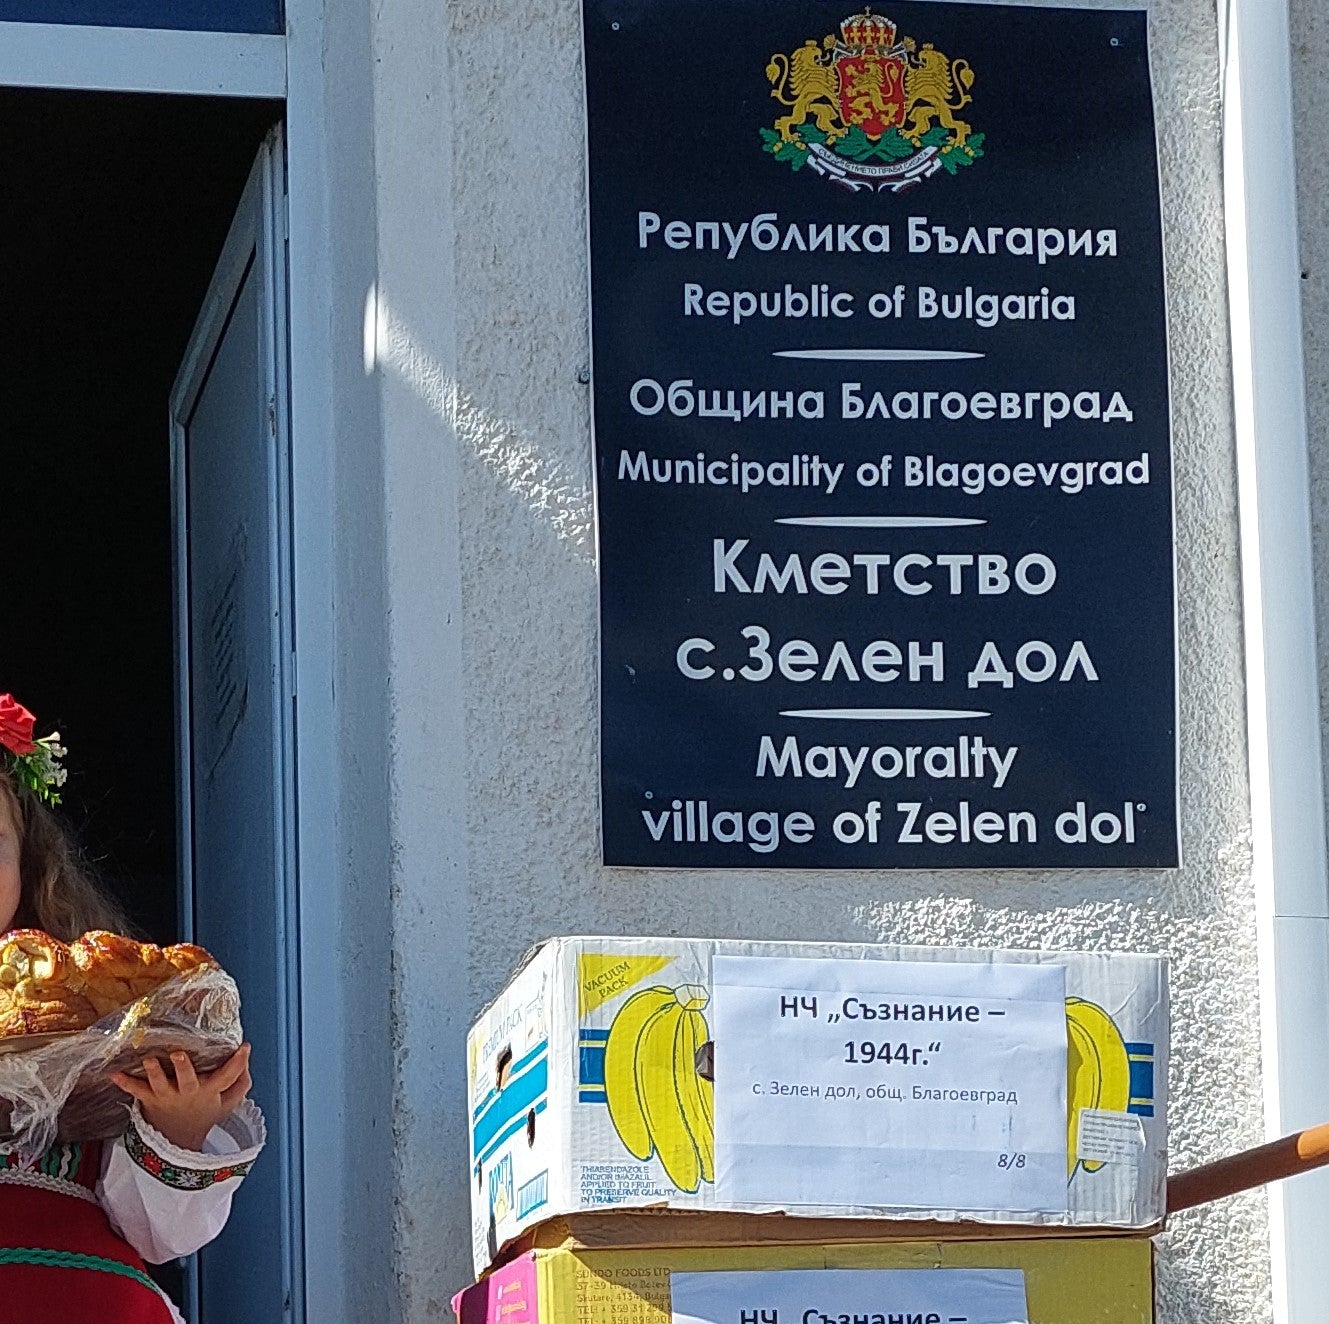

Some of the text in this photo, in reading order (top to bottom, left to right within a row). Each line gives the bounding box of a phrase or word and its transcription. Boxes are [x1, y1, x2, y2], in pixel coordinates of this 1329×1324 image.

[639, 212, 1117, 264] Република България
[685, 284, 1075, 327] Republic of Bulgaria
[630, 379, 1133, 427] Община Благоевград
[618, 450, 1149, 494] Municipality of Blagoevgrad
[714, 539, 1056, 595] Кметство
[677, 626, 1098, 688] с.Зелен дол
[756, 736, 1018, 788] Mayoralty
[642, 800, 1134, 853] village of Zelen dol
[584, 961, 631, 992] VACUUM
[598, 977, 629, 998] PACK
[780, 995, 818, 1019] НЧ
[752, 1080, 1018, 1106] с. Зелен дол, общ. Благоевград
[997, 1152, 1026, 1171] 8/8
[617, 1181, 630, 1189] TO
[641, 1188, 677, 1197] QUALITY
[616, 1268, 651, 1277] FOODS
[654, 1267, 671, 1276] LTD
